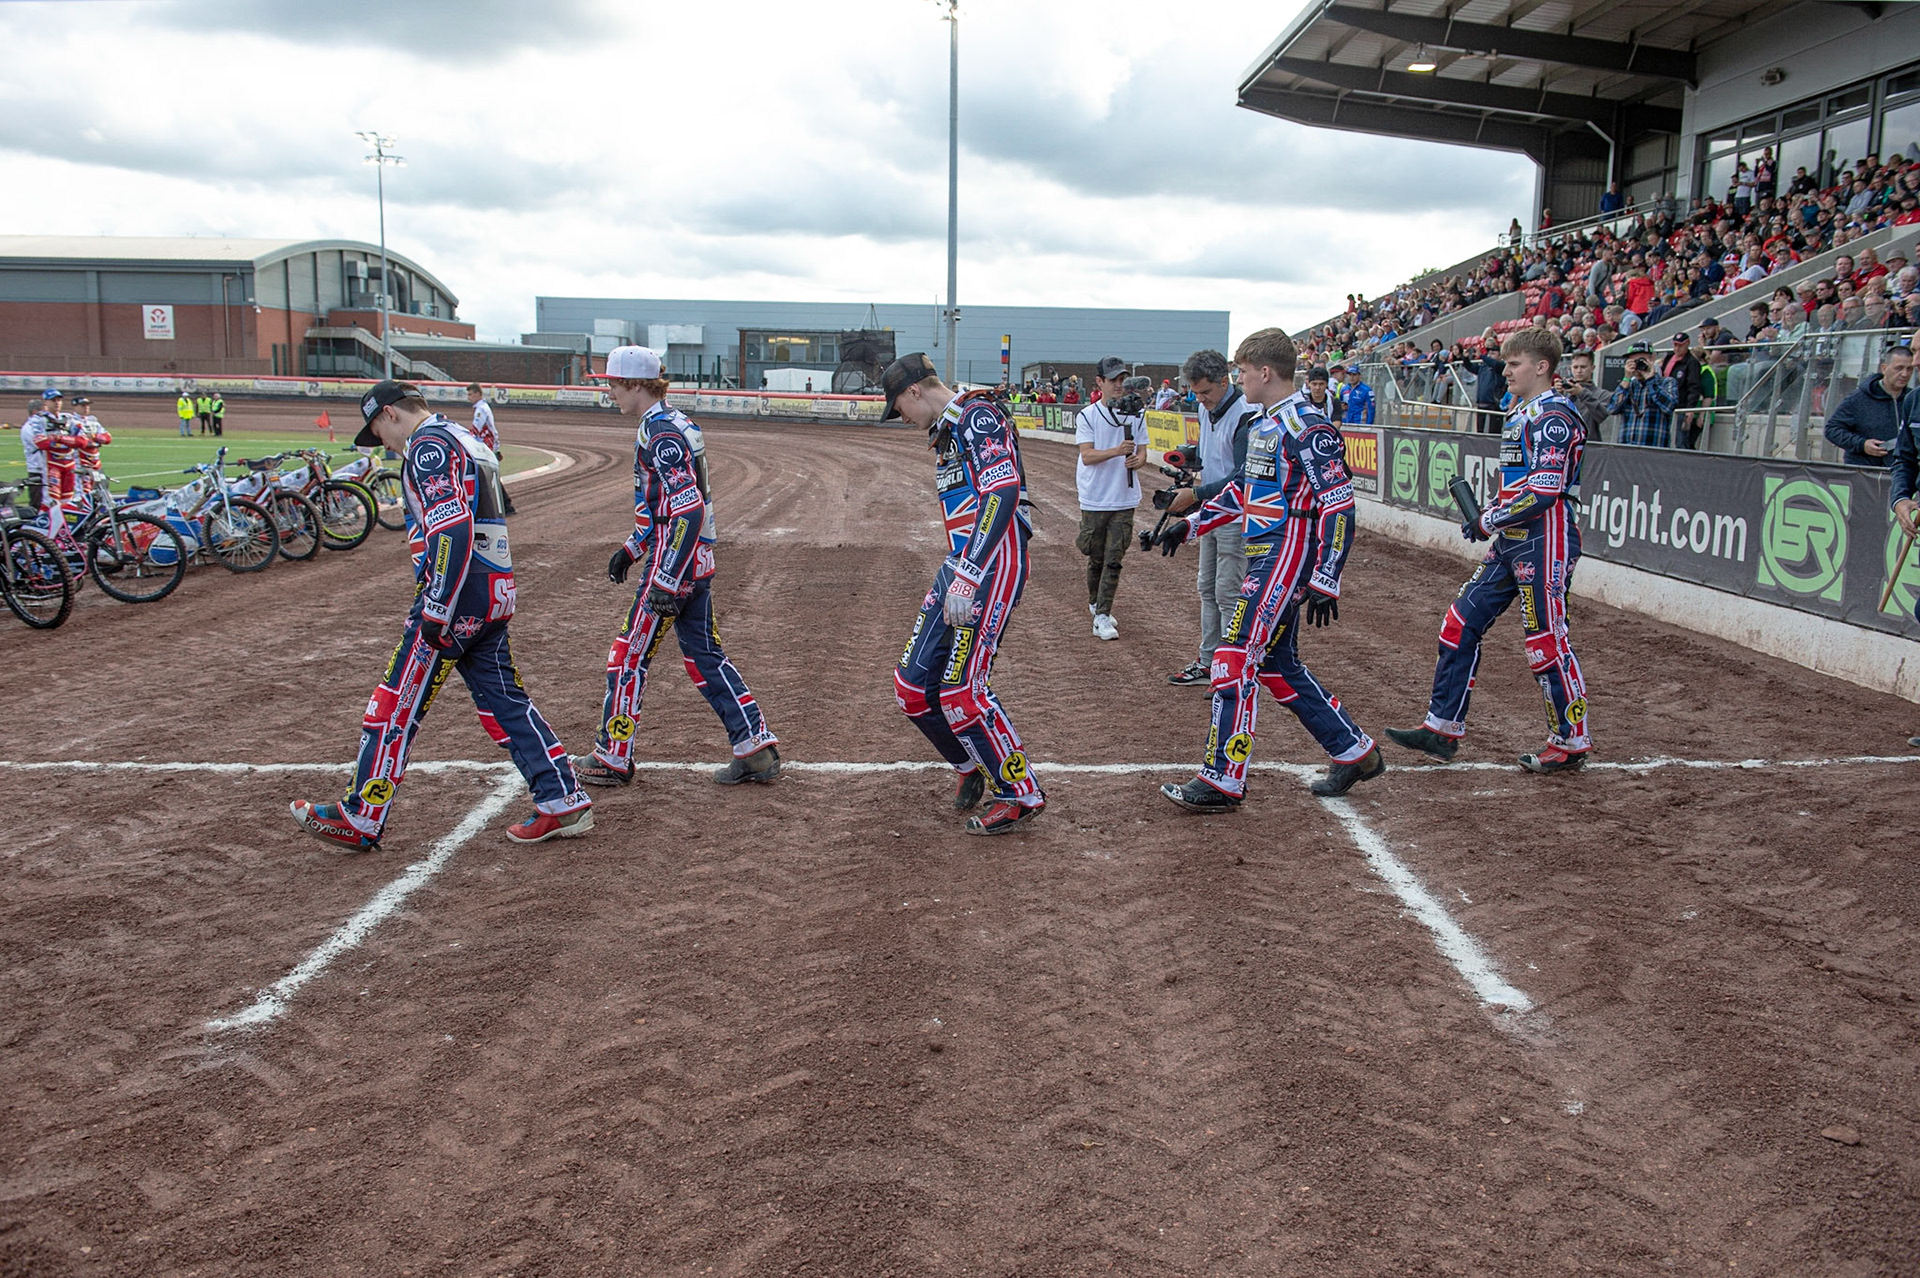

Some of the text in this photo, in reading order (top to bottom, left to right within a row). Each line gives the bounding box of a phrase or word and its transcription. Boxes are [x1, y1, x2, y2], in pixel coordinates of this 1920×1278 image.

[1547, 425, 1565, 435] ATPI
[419, 450, 440, 465] ATPI
[660, 447, 678, 458] ATPI
[427, 500, 458, 519] HAGON
[428, 506, 462, 526] SHOCKS
[981, 496, 998, 532] Mobility
[1575, 480, 1747, 562] -right.com
[437, 537, 449, 573] Mobility
[961, 560, 982, 579] AFEX
[658, 574, 677, 587] AFEX
[1319, 576, 1338, 591] AFEX
[1268, 583, 1284, 608] MCS
[427, 602, 448, 616] AFEX
[1523, 587, 1536, 629] POWER
[943, 629, 962, 680] MAXED
[950, 629, 971, 680] POWER
[434, 659, 453, 683] Seal
[1200, 767, 1225, 782] AFEX
[305, 815, 354, 838] daytona
